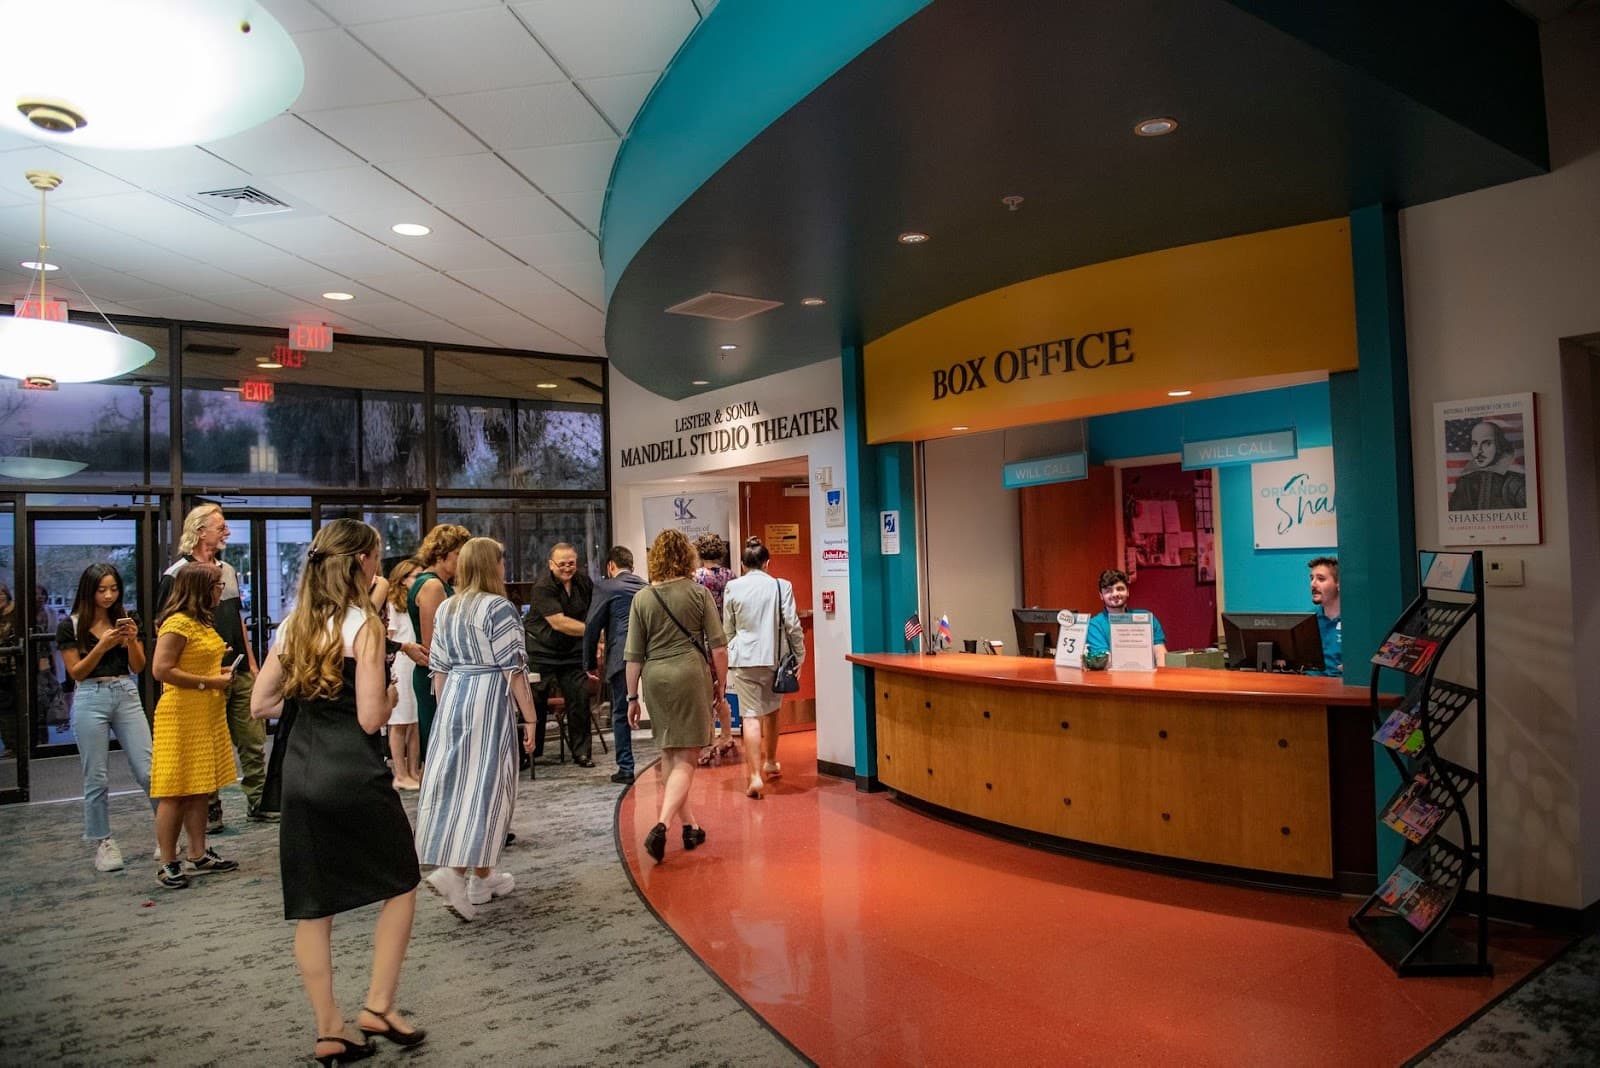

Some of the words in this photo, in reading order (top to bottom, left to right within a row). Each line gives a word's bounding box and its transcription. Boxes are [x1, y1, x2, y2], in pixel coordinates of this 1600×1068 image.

[297, 325, 328, 350] EXIT
[933, 356, 987, 400] BOX
[994, 328, 1134, 384] OFFICE
[244, 381, 270, 401] EXIT
[675, 412, 712, 432] LESTER
[714, 409, 723, 424] &
[725, 400, 760, 422] SONIA
[621, 438, 687, 468] MANDELL
[690, 424, 749, 456] STUDIO
[752, 407, 839, 447] THEATER
[1200, 445, 1233, 460] WILL
[1238, 440, 1278, 456] CALL
[1015, 466, 1041, 480] WILL
[1043, 463, 1073, 476] CALL
[1261, 483, 1329, 498] ORLANDO
[1276, 473, 1336, 535] Sha
[1448, 511, 1528, 523] SHAKESPEARE
[1254, 619, 1277, 627] DELL
[1063, 637, 1076, 653] $3
